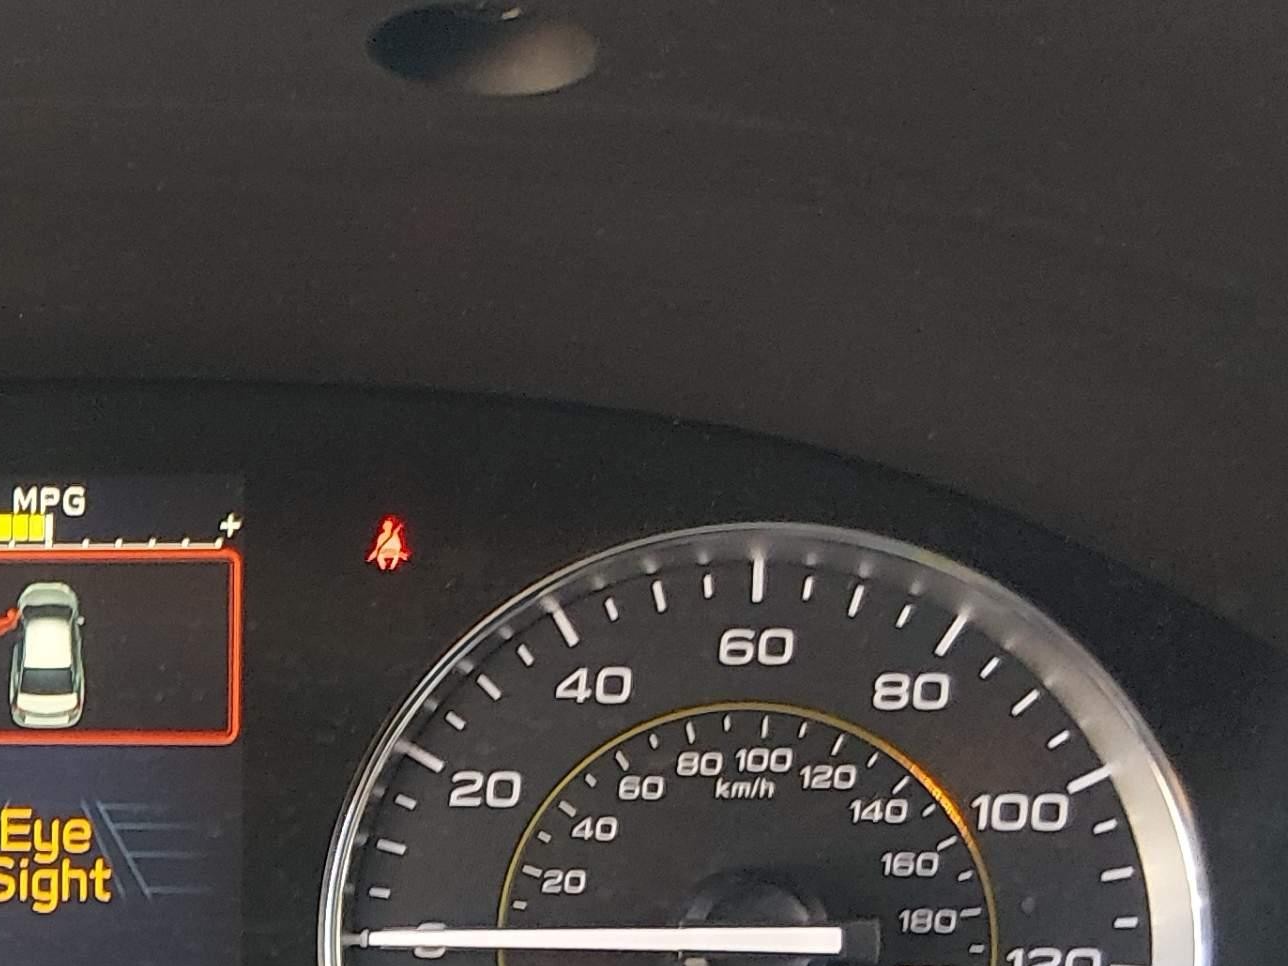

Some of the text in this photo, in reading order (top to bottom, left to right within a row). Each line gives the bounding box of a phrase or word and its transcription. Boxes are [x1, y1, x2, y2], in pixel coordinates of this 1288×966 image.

[13, 486, 86, 516] MPG
[719, 628, 794, 665] 60
[555, 667, 632, 705] 40
[873, 673, 950, 710] 80
[677, 751, 723, 777] 80
[735, 748, 792, 772] 100
[449, 771, 521, 808] 20
[618, 776, 664, 801] 60
[715, 777, 774, 801] km/h
[800, 765, 856, 790] 120
[850, 799, 908, 826] 140
[971, 793, 1069, 831] 100
[0, 808, 92, 863] Eye
[572, 816, 618, 841] 40
[881, 852, 939, 877] 160
[541, 870, 587, 895] 20
[899, 908, 957, 934] 180
